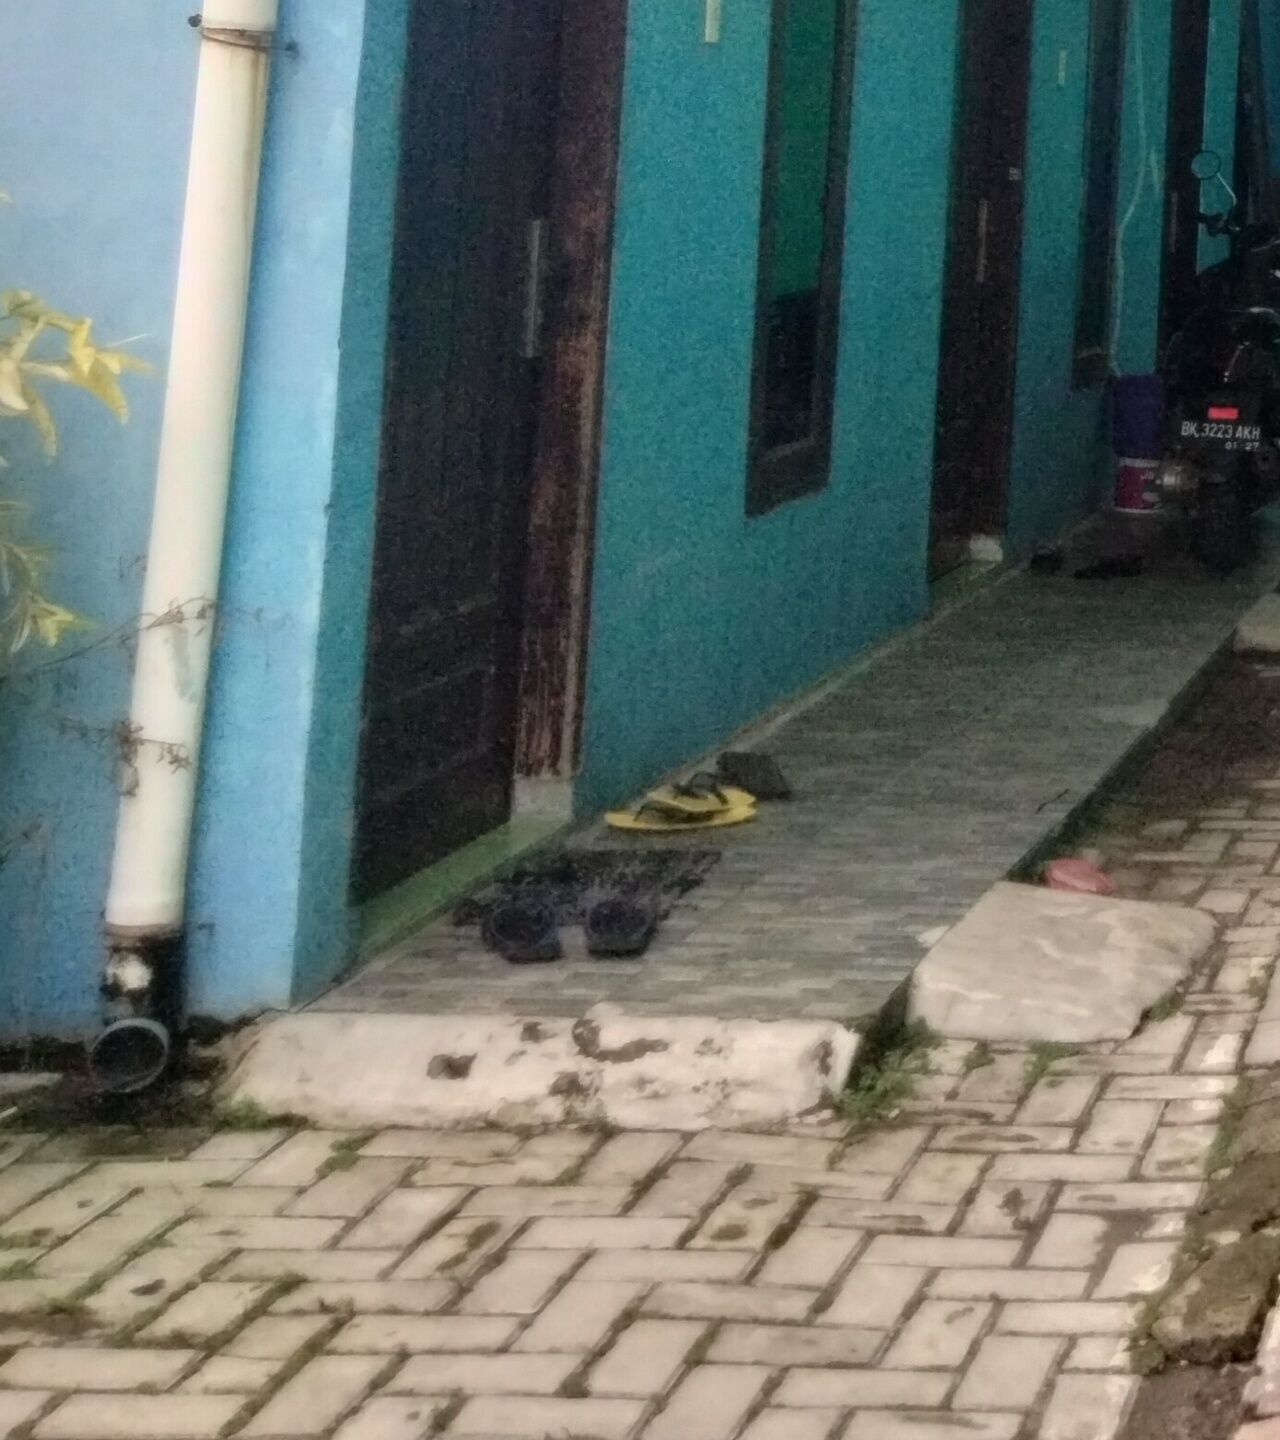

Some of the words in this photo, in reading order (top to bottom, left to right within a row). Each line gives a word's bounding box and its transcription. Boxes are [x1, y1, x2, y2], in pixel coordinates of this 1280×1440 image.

[1181, 421, 1199, 438] BK
[1201, 423, 1233, 439] 3223
[1235, 425, 1261, 440] AKH
